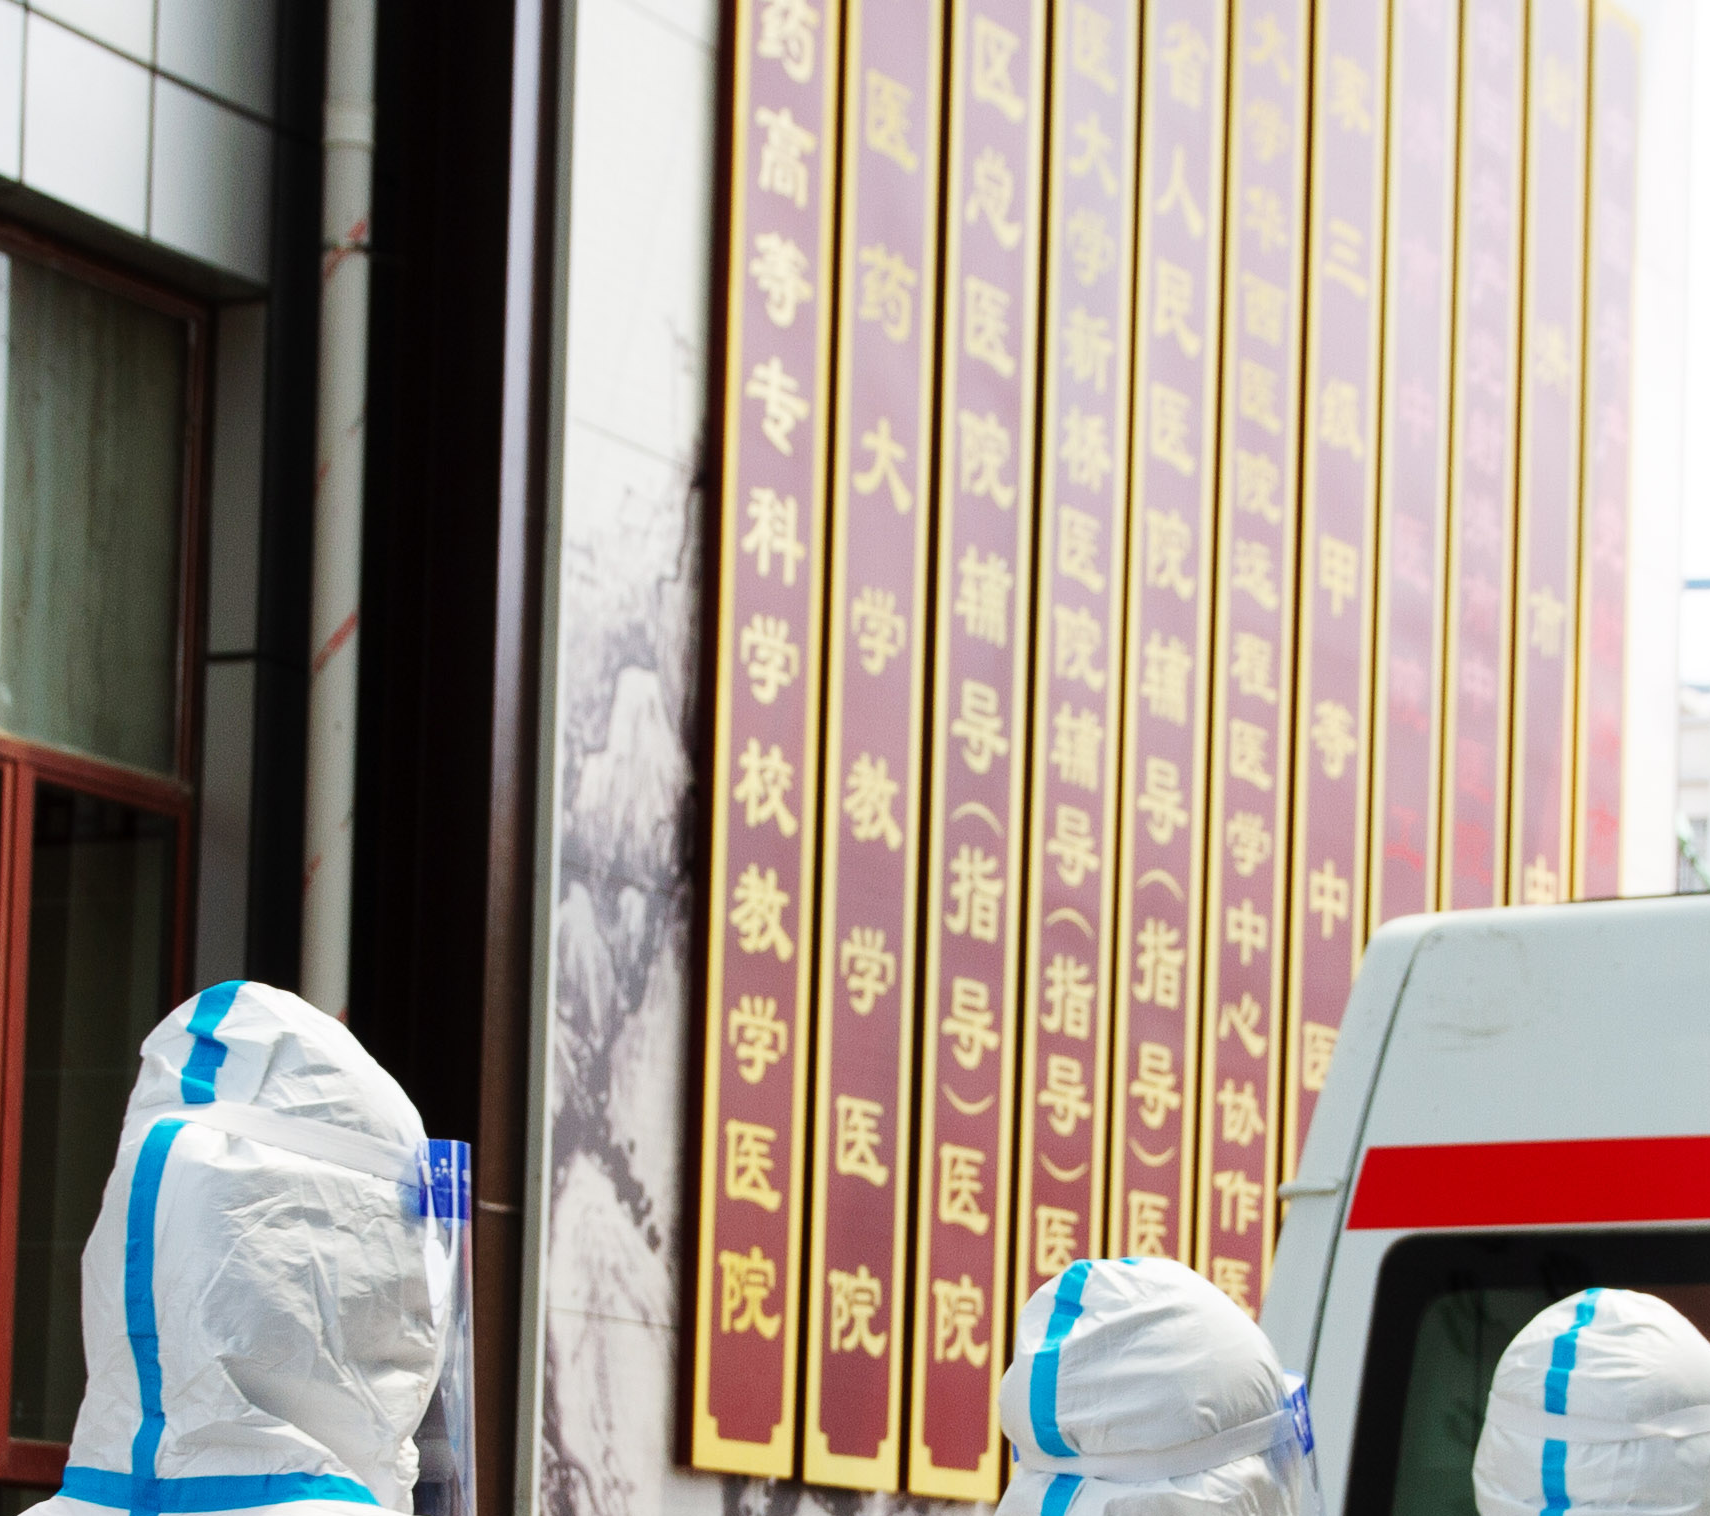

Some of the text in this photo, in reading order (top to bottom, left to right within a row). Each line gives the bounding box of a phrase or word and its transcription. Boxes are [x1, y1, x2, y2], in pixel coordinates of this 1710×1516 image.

[829, 66, 920, 1360] 医药大学教学医院
